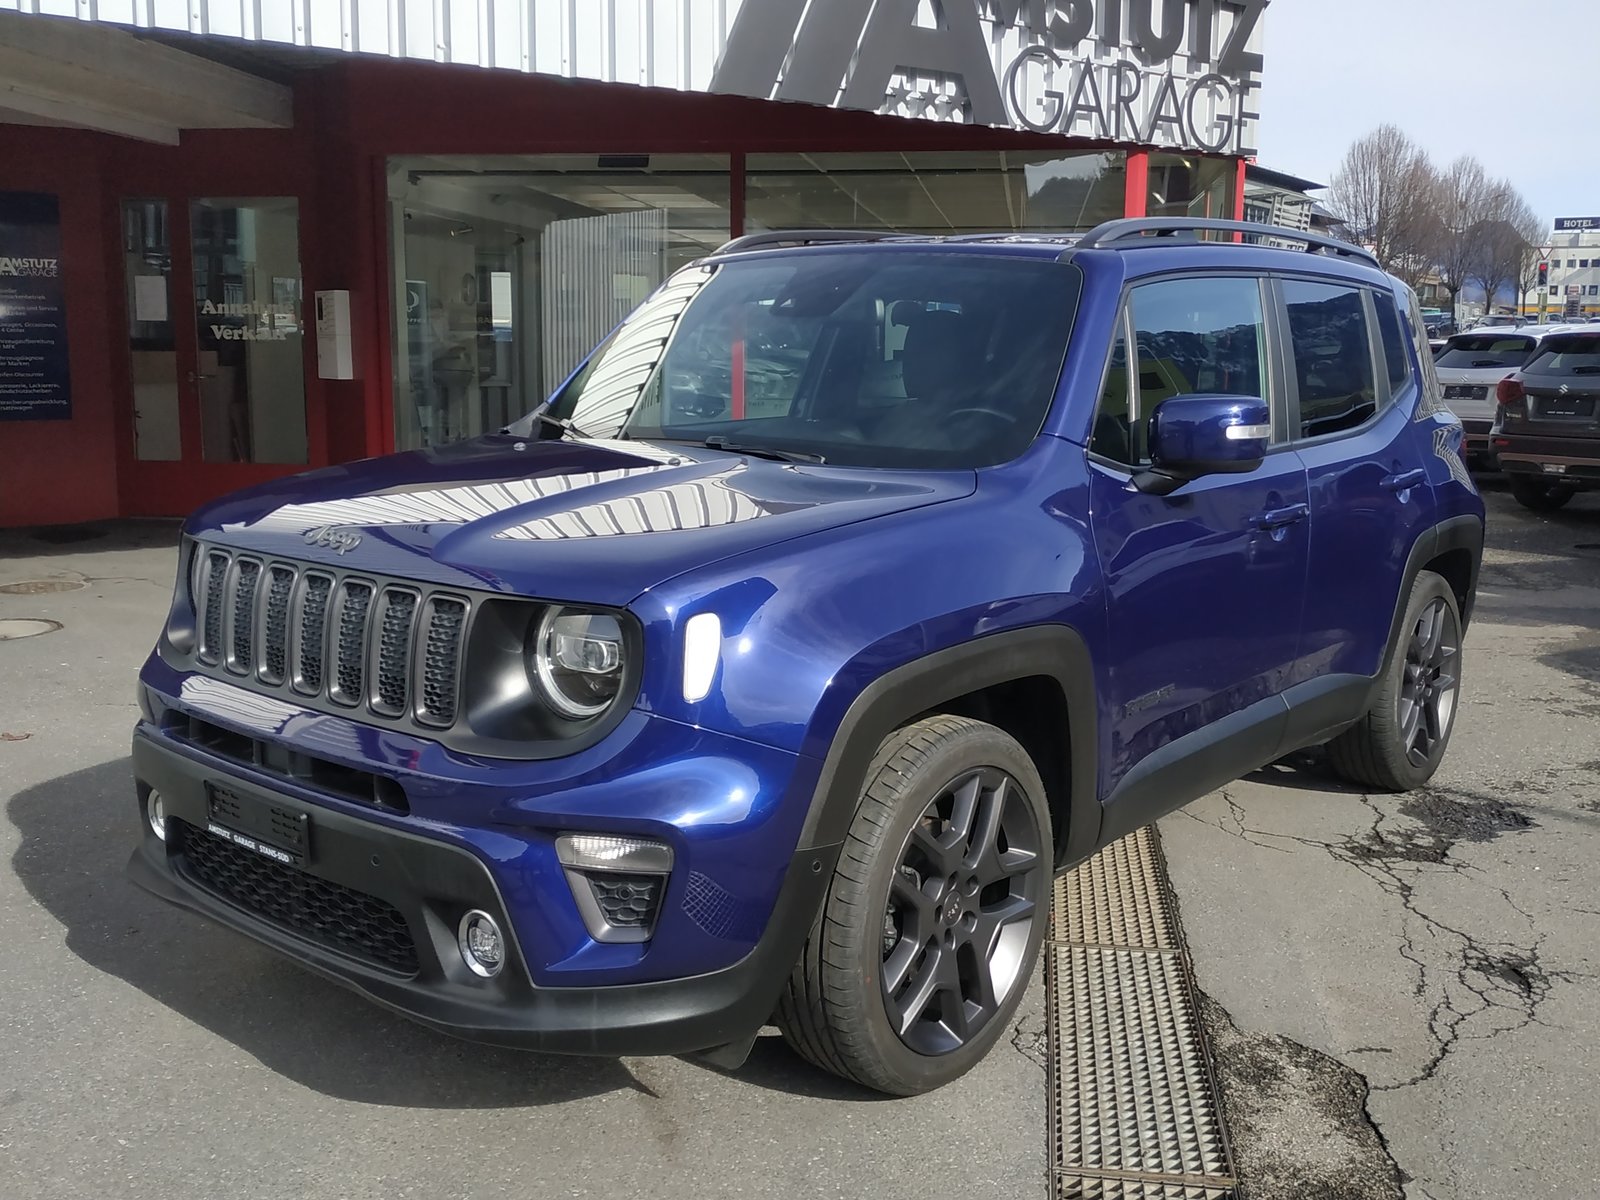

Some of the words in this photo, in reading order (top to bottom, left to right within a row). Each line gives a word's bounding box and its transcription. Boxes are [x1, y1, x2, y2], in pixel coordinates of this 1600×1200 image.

[1009, 45, 1261, 156] GARAGE
[1563, 219, 1594, 228] HOTEL
[0, 257, 57, 275] AMSTUTZ
[17, 267, 58, 277] GARAGE
[304, 525, 362, 556] Jeep
[208, 824, 231, 840] AMSTUTZ
[233, 834, 256, 850] GARAGE
